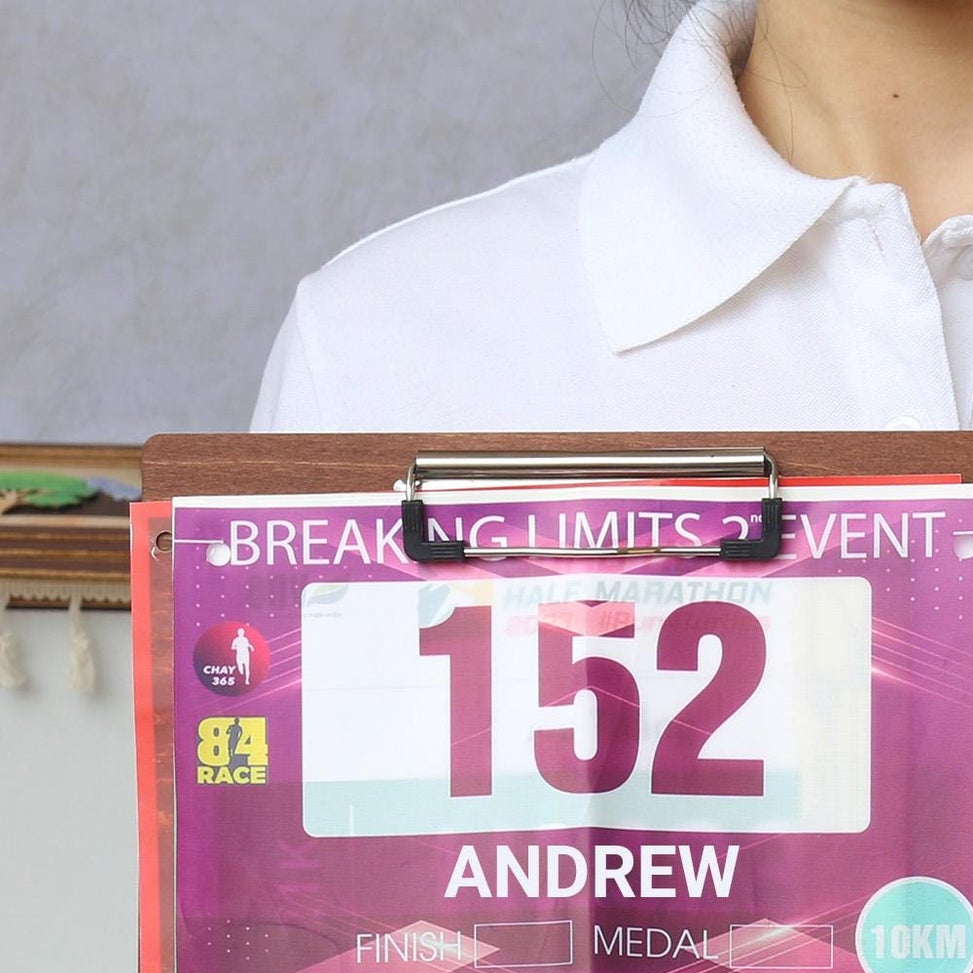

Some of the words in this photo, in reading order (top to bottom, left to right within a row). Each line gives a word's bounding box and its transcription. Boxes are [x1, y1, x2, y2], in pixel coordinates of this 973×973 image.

[230, 515, 505, 566] BREAKNG
[203, 665, 237, 675] CHAY
[211, 676, 235, 686] 365
[418, 599, 768, 798] 152
[197, 717, 269, 767] 84
[197, 766, 267, 785] RACE
[443, 844, 740, 899] ANDREW
[356, 930, 462, 964] FINISH
[593, 924, 719, 961] MEDAL
[870, 923, 967, 960] 10KM
